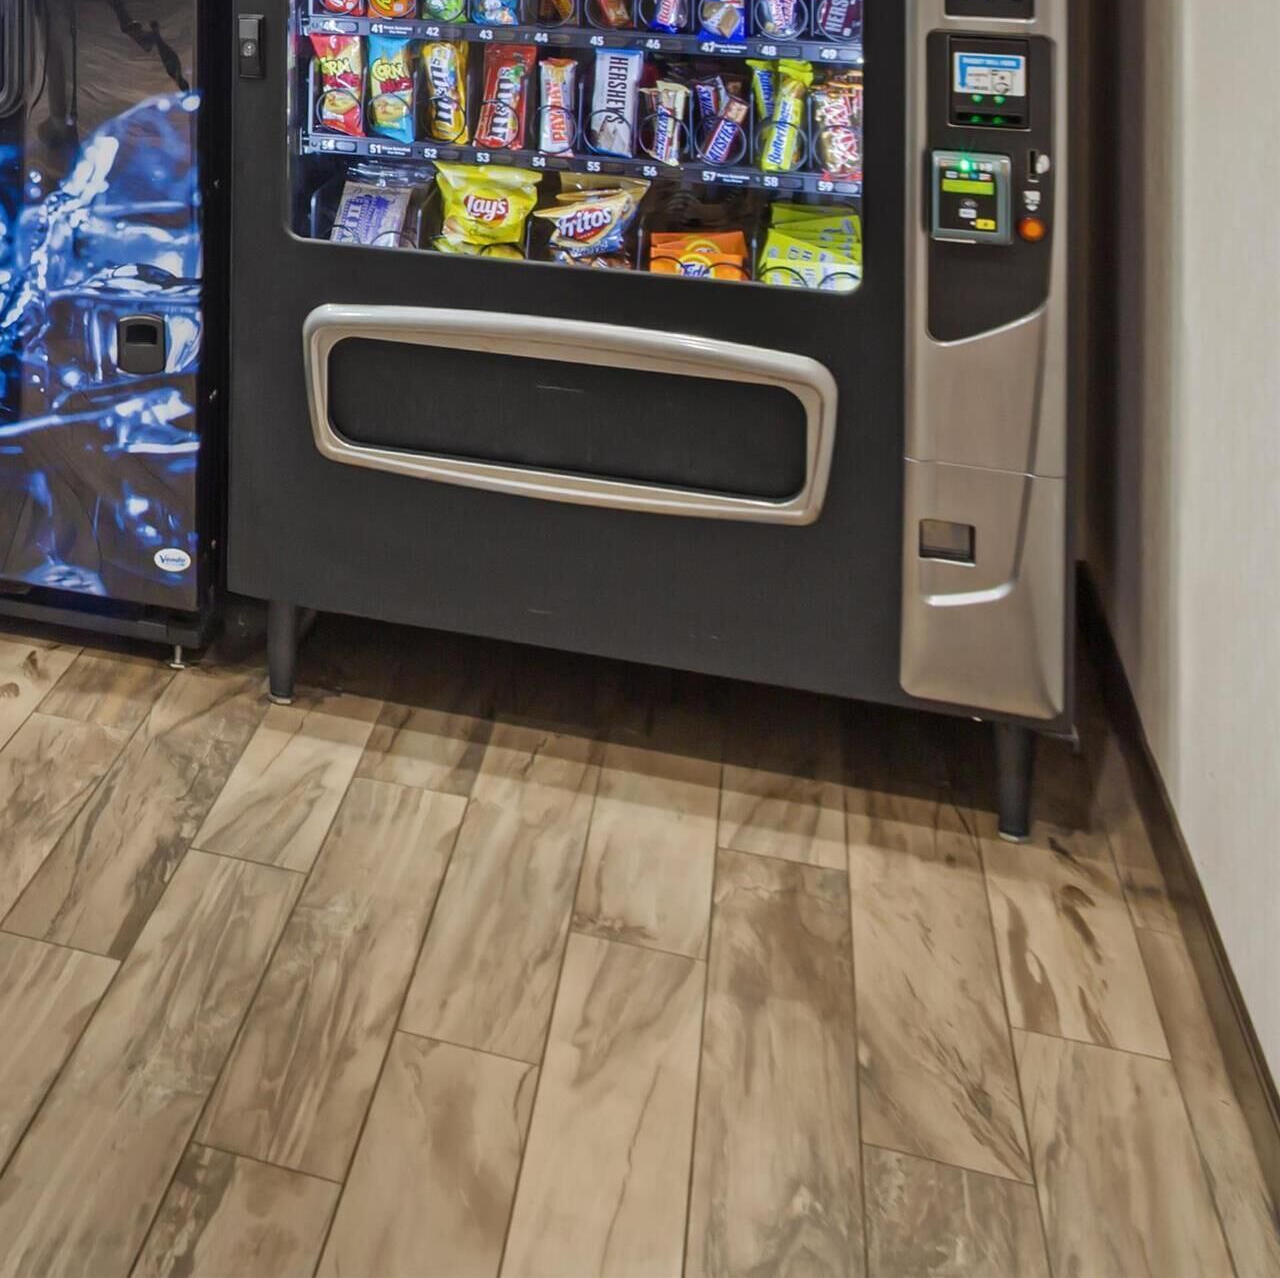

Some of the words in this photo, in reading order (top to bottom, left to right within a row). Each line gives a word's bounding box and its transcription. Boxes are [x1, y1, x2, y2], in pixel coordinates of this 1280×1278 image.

[371, 24, 383, 34] 41
[426, 26, 439, 37] 42
[479, 30, 493, 40] 43
[534, 32, 548, 43] 44
[590, 35, 604, 46] 45
[646, 39, 661, 50] 46
[761, 45, 776, 56] 48
[821, 47, 837, 59] 49
[707, 119, 737, 162] ATISFIES
[370, 143, 382, 154] 51
[424, 147, 438, 158] 52
[477, 152, 490, 163] 53
[532, 156, 546, 167] 54
[587, 161, 600, 172] 55
[643, 166, 657, 177] 56
[702, 171, 716, 182] 57
[764, 176, 778, 187] 58
[818, 181, 833, 192] 59
[467, 195, 508, 220] Lay's
[558, 207, 613, 237] Fritos
